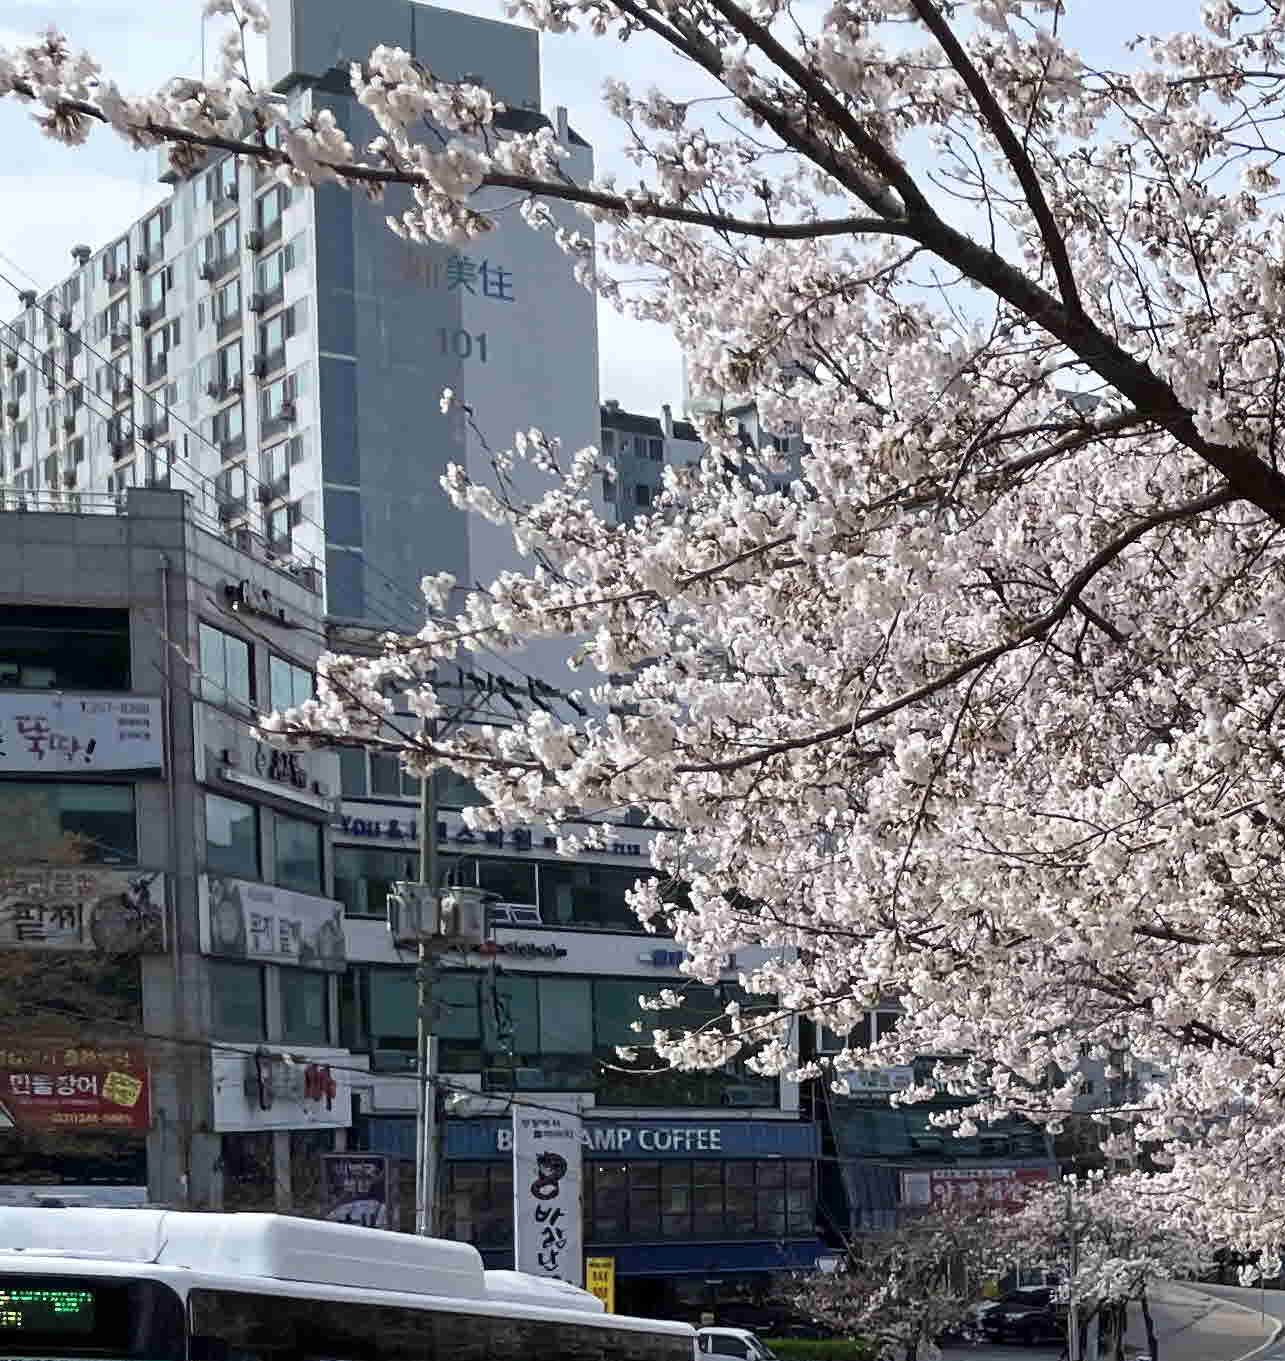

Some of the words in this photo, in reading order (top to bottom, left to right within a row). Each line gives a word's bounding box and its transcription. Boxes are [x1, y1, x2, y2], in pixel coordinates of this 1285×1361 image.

[437, 328, 487, 363] 101
[581, 1129, 631, 1150] AMP
[639, 1129, 722, 1150] COFFEE
